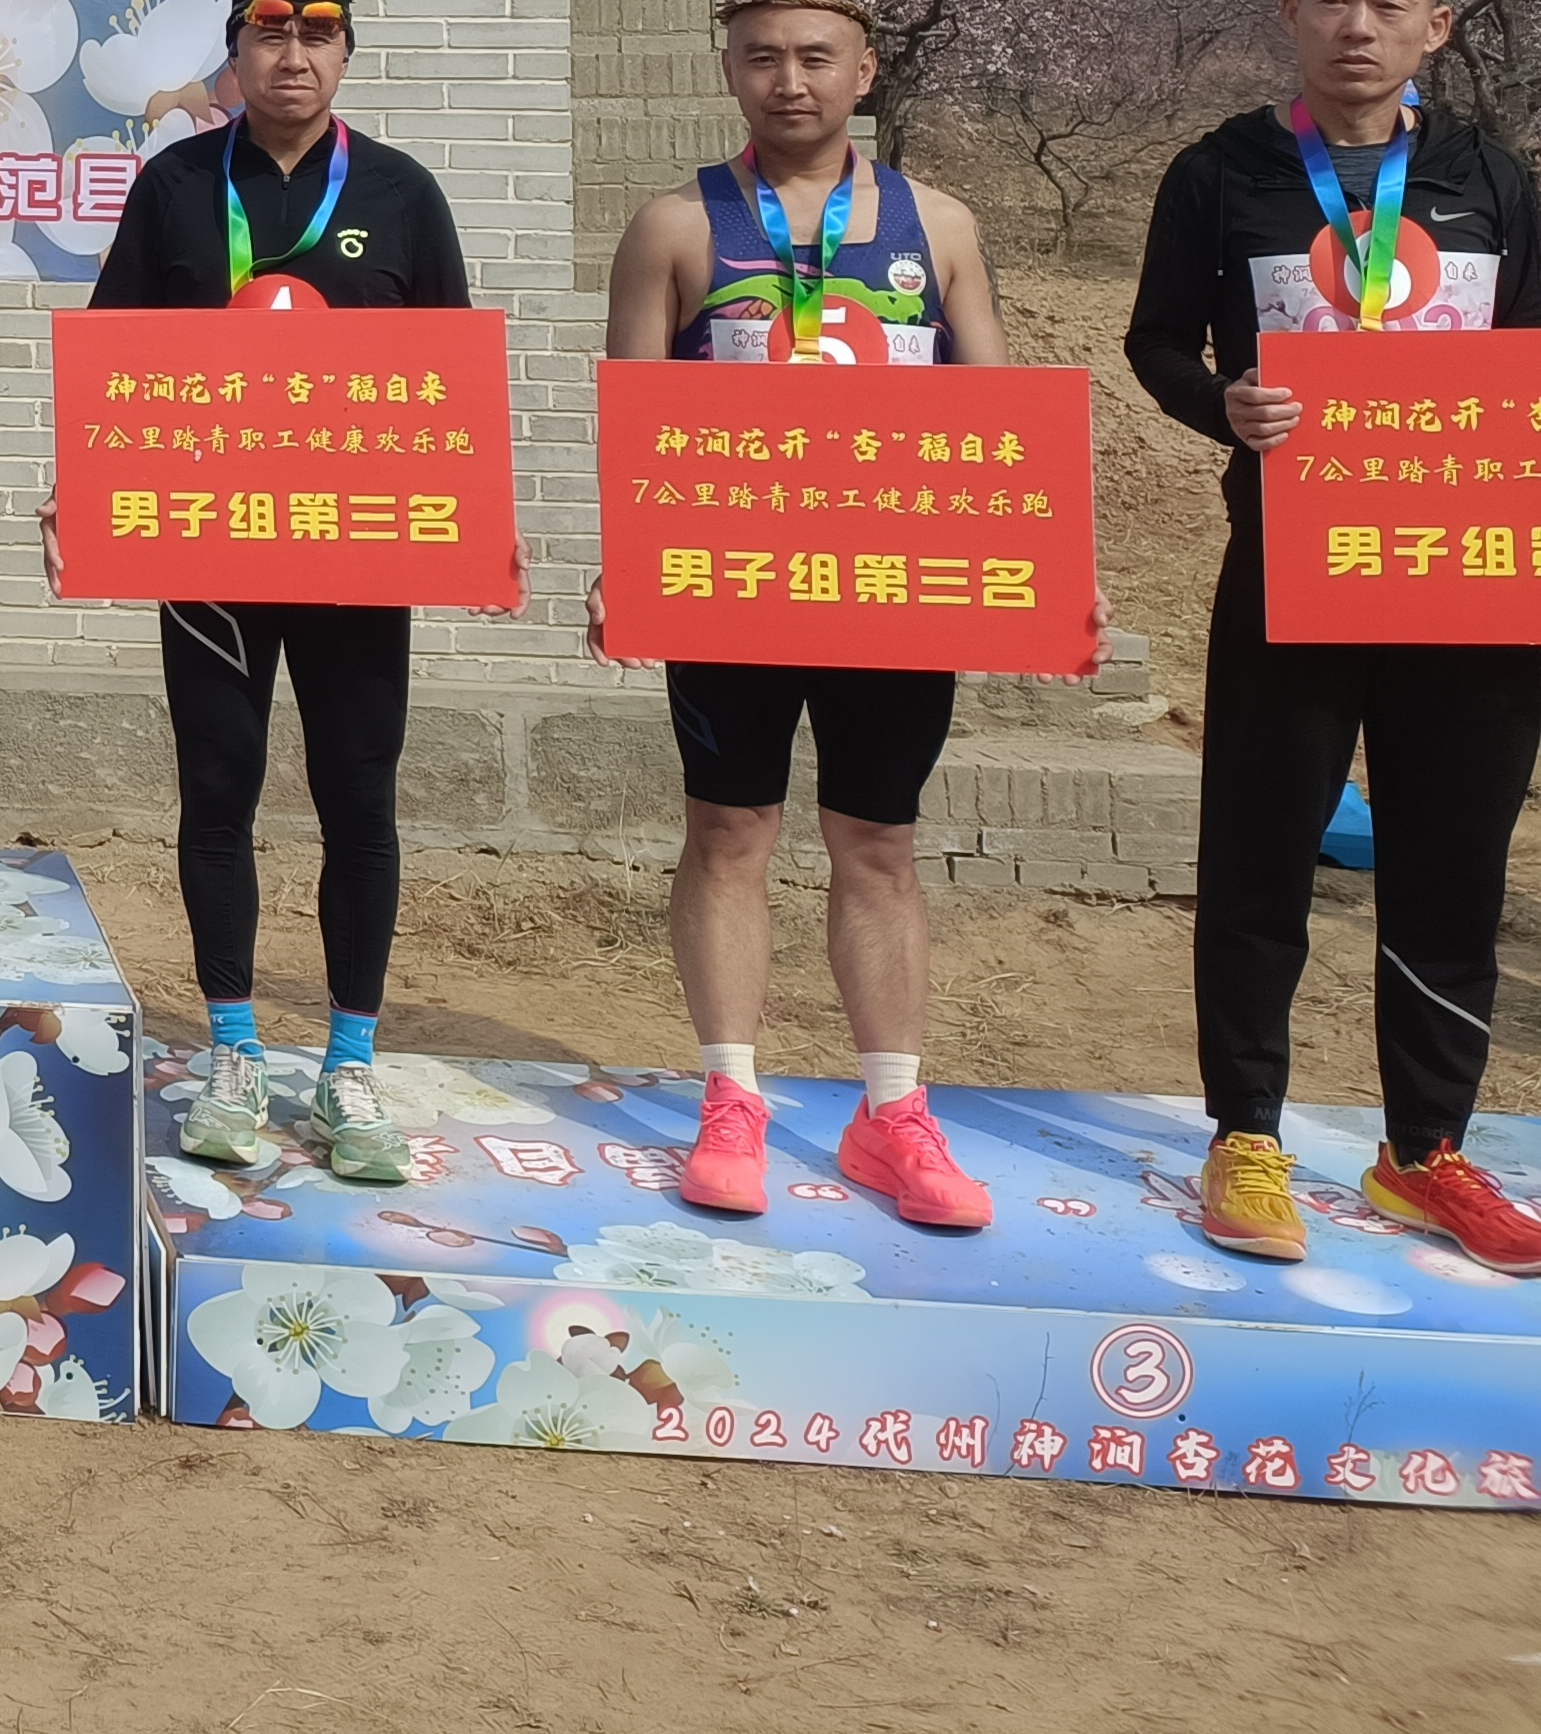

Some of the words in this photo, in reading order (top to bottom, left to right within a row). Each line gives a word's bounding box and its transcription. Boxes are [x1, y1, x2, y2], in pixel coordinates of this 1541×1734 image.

[104, 370, 449, 407] 神涧花开“杏”福自来
[84, 422, 476, 457] 7公里踏青职工健康欢乐跑
[654, 423, 1027, 468] 神涧花开“杏”福自来
[110, 488, 461, 544] 男子组第三名
[631, 477, 1053, 520] 7公里踏青职工健康欢乐跑
[1325, 525, 1541, 579] 男子组
[659, 546, 1038, 609] 男子组第三名
